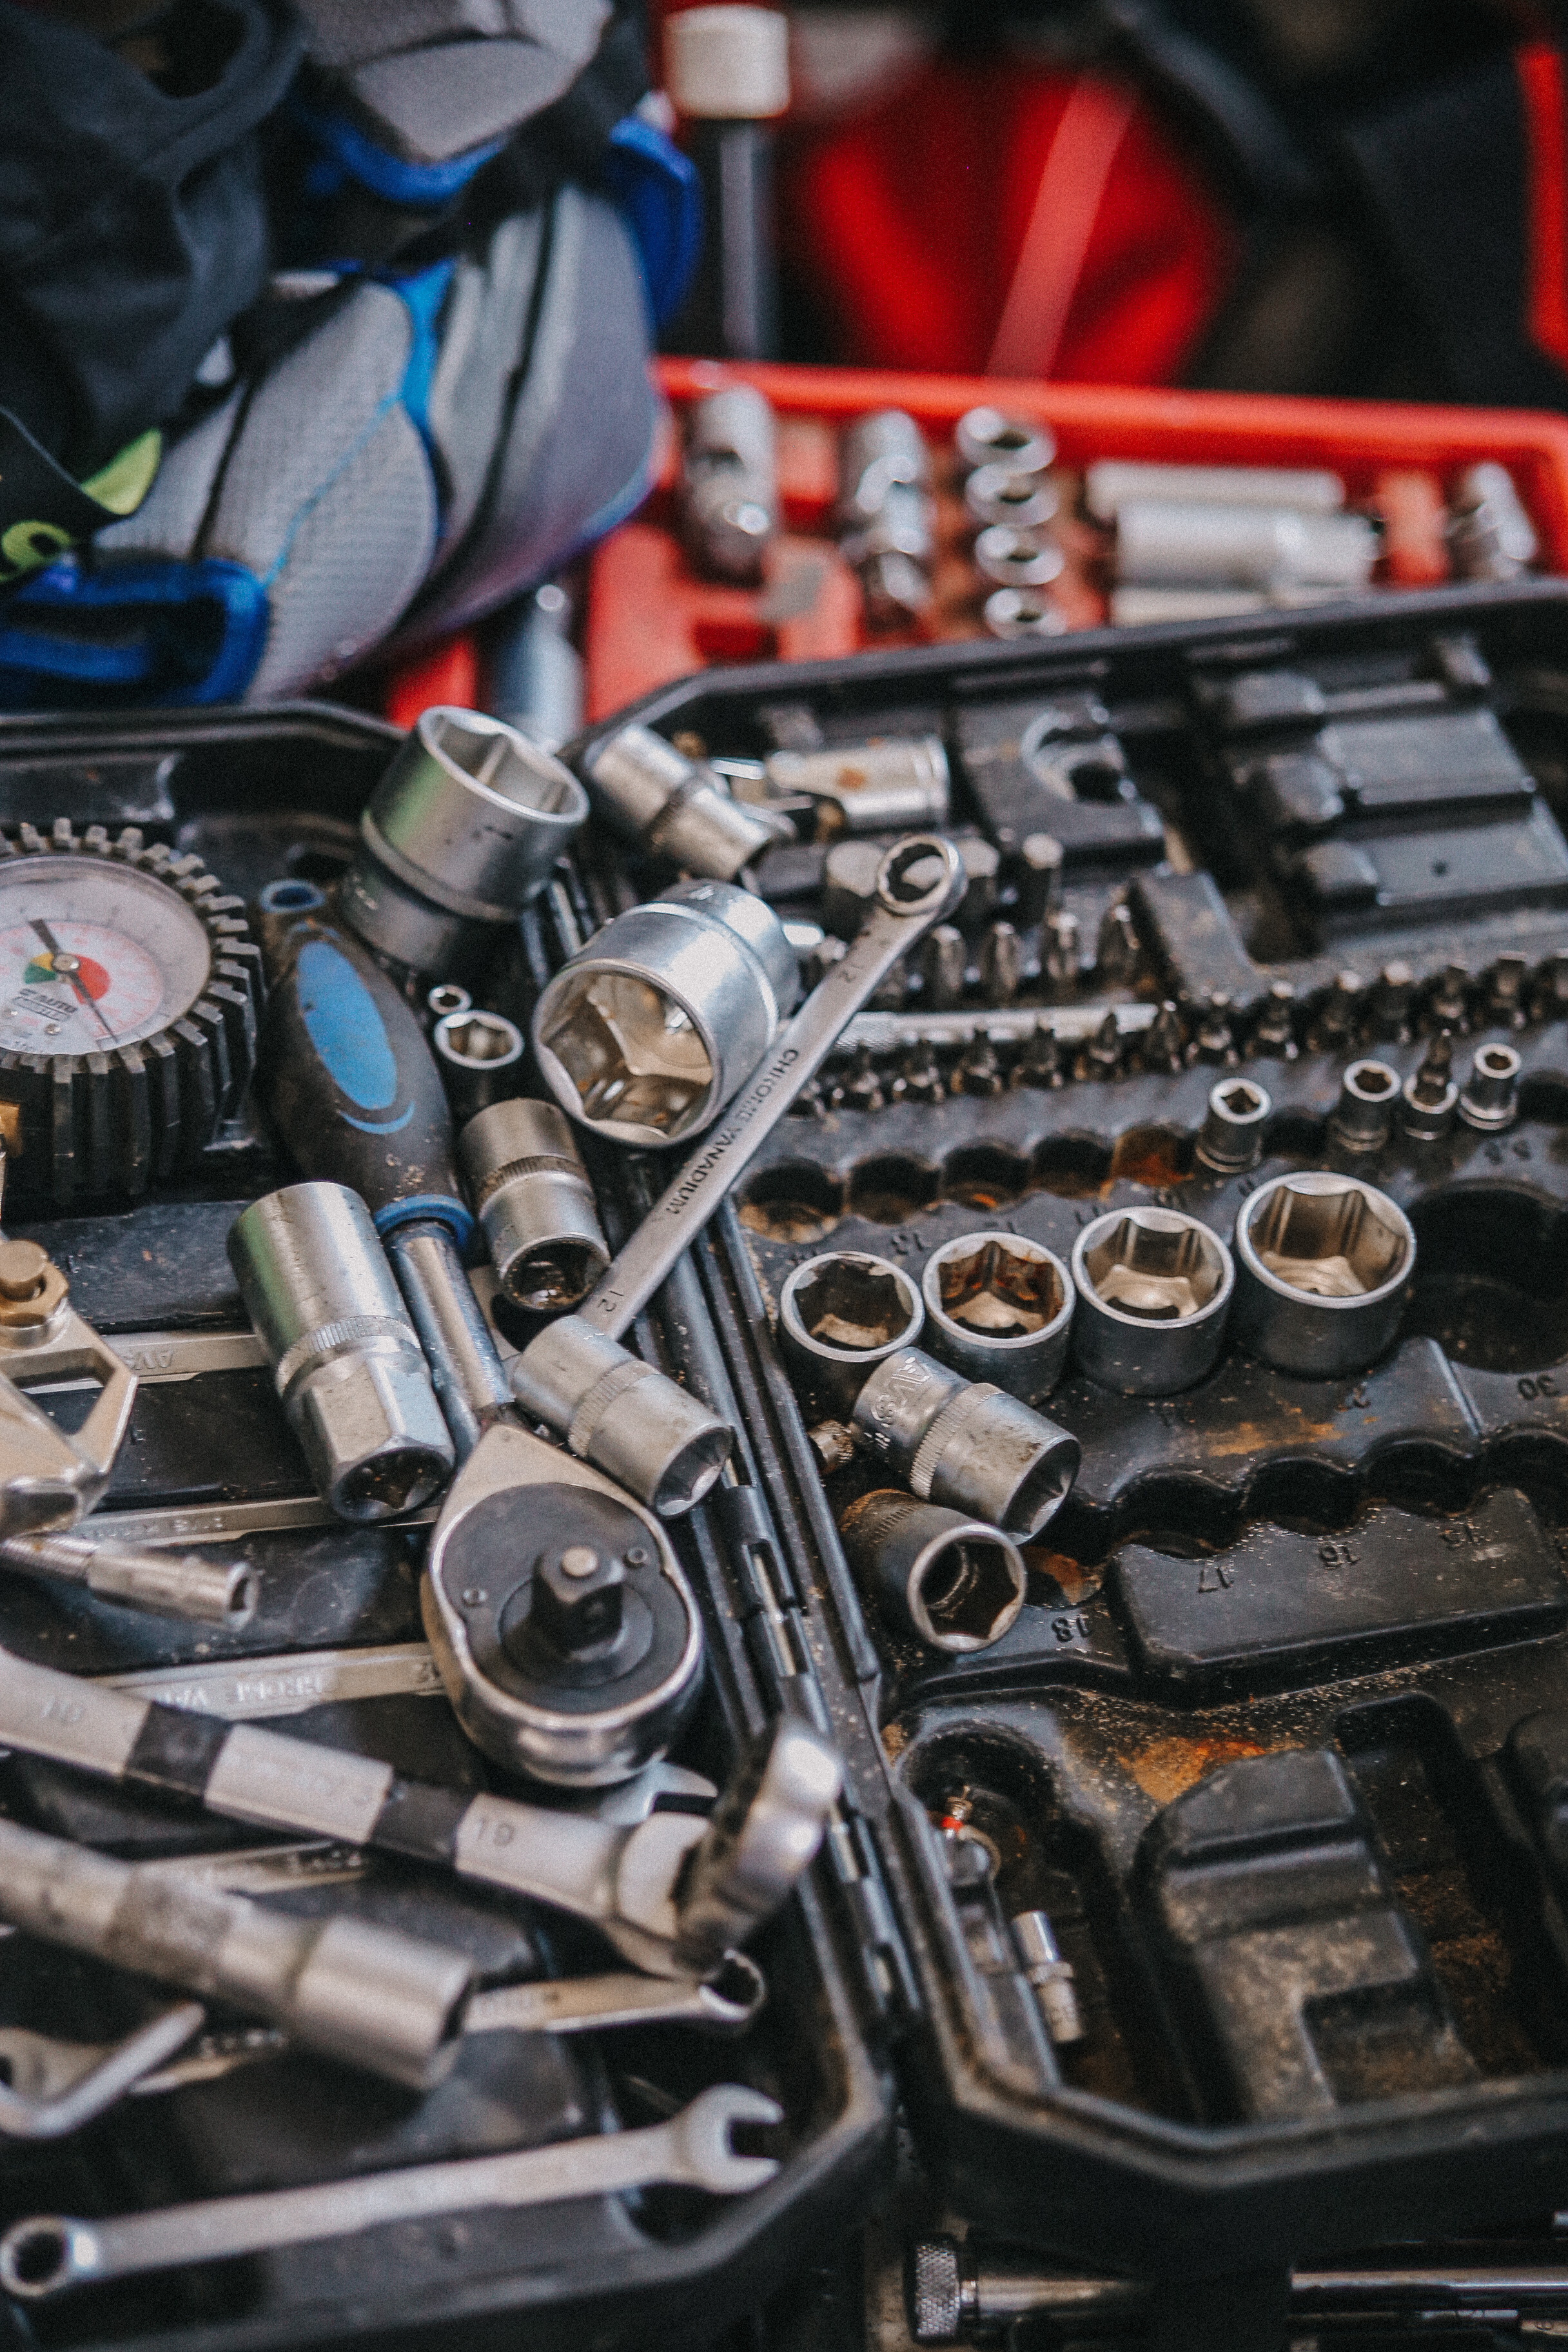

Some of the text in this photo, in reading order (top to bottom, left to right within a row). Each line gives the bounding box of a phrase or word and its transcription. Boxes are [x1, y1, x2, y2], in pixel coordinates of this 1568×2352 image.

[665, 1049, 800, 1216] CHROME VANADIUM
[1516, 1374, 1561, 1402] 30
[1197, 1567, 1235, 1594] 17
[1052, 1616, 1090, 1643] 18
